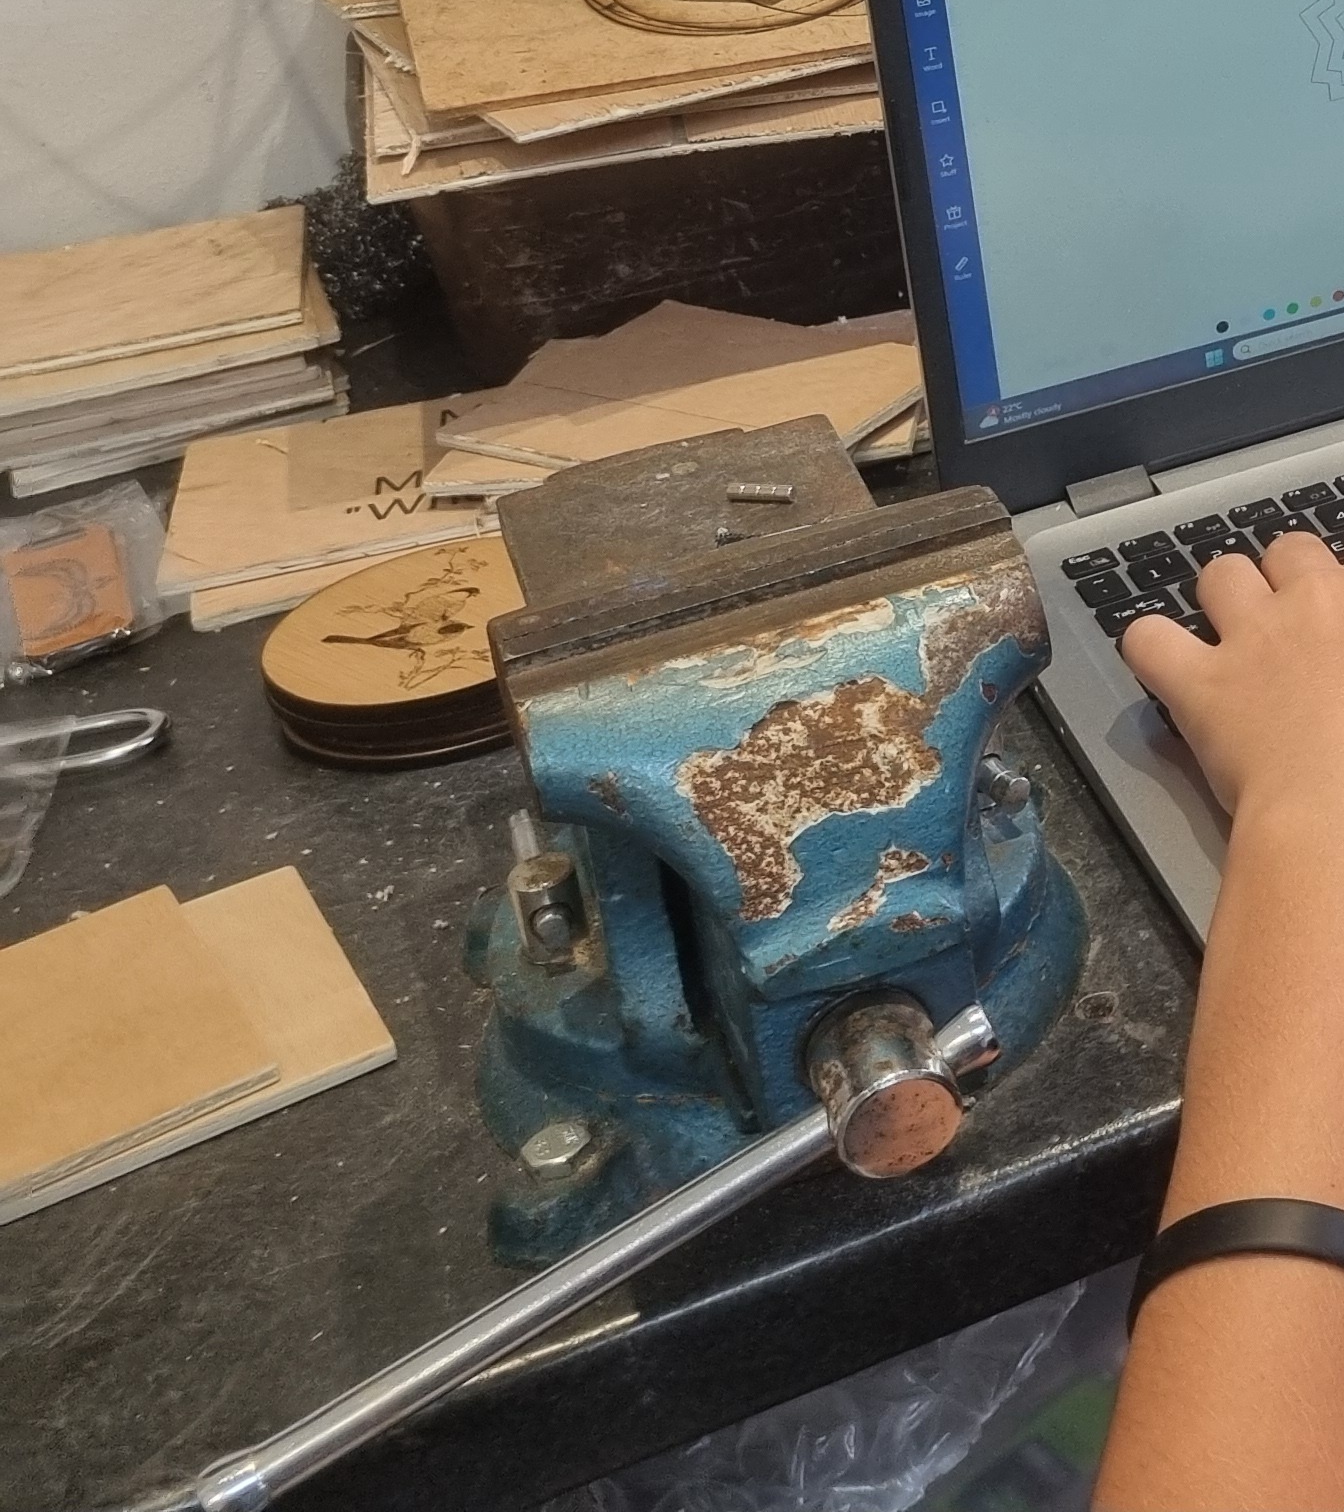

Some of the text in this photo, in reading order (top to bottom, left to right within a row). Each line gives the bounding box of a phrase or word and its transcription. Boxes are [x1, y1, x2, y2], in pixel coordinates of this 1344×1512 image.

[914, 9, 937, 19] Image
[922, 63, 944, 72] Word
[940, 168, 959, 179] Stuff
[943, 220, 968, 232] Project
[1003, 403, 1062, 424] Mostly cloudy
[1068, 554, 1090, 565] Esc
[1124, 539, 1138, 548] F1
[1179, 522, 1194, 531] F2
[1234, 505, 1248, 514] F3
[1288, 489, 1301, 498] F4
[1112, 607, 1136, 619] Tab
